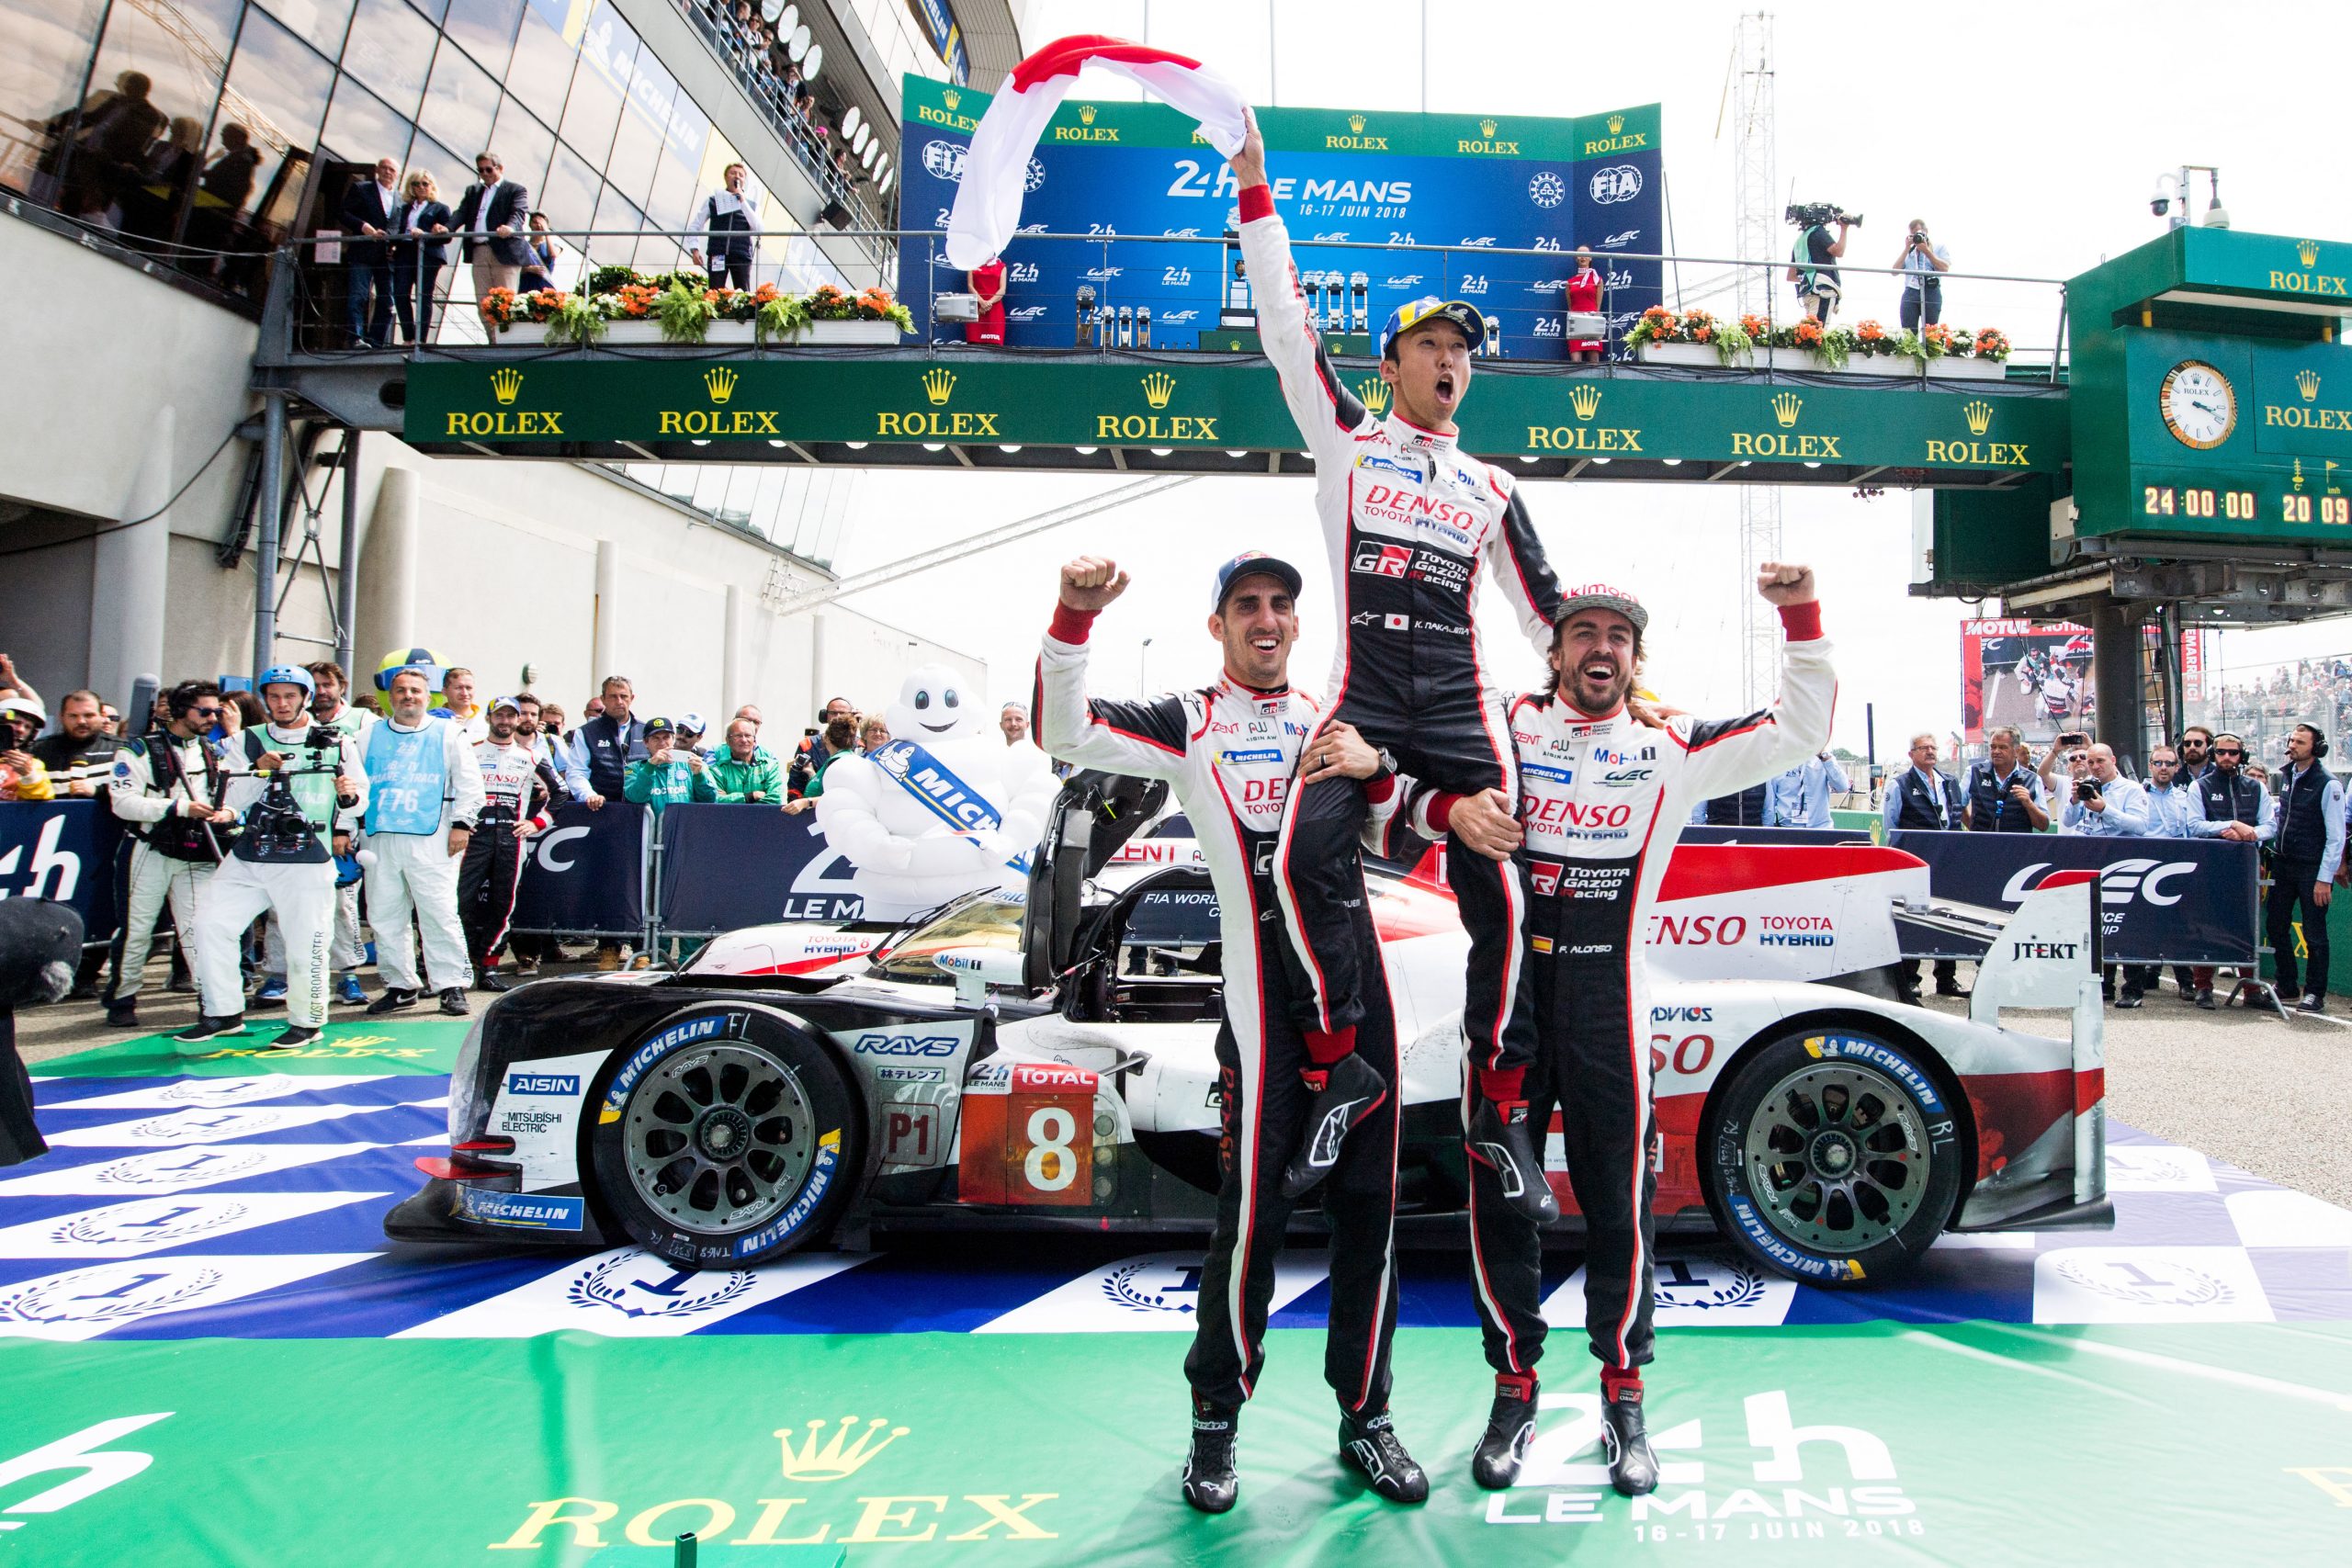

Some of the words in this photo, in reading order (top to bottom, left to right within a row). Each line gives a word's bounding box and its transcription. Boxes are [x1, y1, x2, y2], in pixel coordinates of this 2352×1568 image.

[613, 51, 700, 151] MICHELIN
[1055, 127, 1120, 141] ROLEX
[1326, 136, 1389, 150] ROLEX
[1457, 140, 1520, 154] ROLEX
[1585, 133, 1646, 154] ROLEX
[1273, 178, 1296, 199] E
[1302, 179, 1412, 204] MANS
[1299, 204, 1335, 217] 16-17
[1340, 205, 1370, 218] JUIN
[1374, 207, 1407, 219] 2018
[1164, 229, 1201, 237] WEC
[1314, 232, 1350, 242] WEC
[1605, 230, 1640, 244] WEC
[1461, 237, 1497, 246] WEC
[1011, 263, 1038, 277] 24h
[1087, 267, 1124, 277] WEC
[1162, 266, 1191, 281] 24h
[1387, 275, 1423, 285] WEC
[1461, 275, 1487, 289] 24h
[2269, 272, 2347, 296] ROLEX
[1010, 307, 1047, 317] WEC
[1162, 310, 1199, 321] WEC
[1533, 318, 1561, 333] 24h
[2183, 388, 2210, 396] ROLEX
[447, 412, 563, 435] ROLEX
[659, 412, 779, 434] ROLEX
[876, 413, 1000, 437] ROLEX
[2265, 406, 2352, 431] ROLEX
[1097, 415, 1218, 440] ROLEX
[1527, 426, 1644, 451] ROLEX
[1731, 433, 1841, 457] ROLEX
[1926, 441, 2030, 466] ROLEX
[1365, 484, 1474, 530] DENSO
[2283, 496, 2312, 523] 20
[2322, 498, 2350, 525] 09
[1364, 506, 1412, 525] TOYOTA
[1416, 517, 1468, 545] HYBRID
[1354, 554, 1407, 576] GR
[1415, 560, 1467, 581] GAZOO
[1408, 570, 1462, 592] Racing
[1964, 622, 2030, 635] MOTUL
[1212, 721, 1239, 734] ZENT
[1236, 752, 1277, 761] MICHELIN
[1522, 766, 1566, 780] MICHELIN
[1605, 770, 1653, 781] WEC
[111, 780, 132, 791] 35
[1245, 803, 1285, 815] TOYOT
[1522, 795, 1631, 828] DENSO
[1566, 828, 1629, 840] HYBRID
[1112, 842, 1176, 863] ENT
[1567, 866, 1631, 877] TOYOTA
[1564, 878, 1623, 888] GAZOO
[1145, 894, 1170, 904] FIA
[1175, 894, 1218, 905] WORL
[1559, 888, 1618, 901] Racing
[783, 899, 827, 919] LE
[1760, 917, 1833, 930] TOYOTA
[808, 935, 857, 943] TOYOTA
[1760, 933, 1833, 947] HYBRID
[805, 945, 856, 953] HYBRID
[1570, 944, 1612, 953] ALONSO
[2012, 942, 2077, 962] JTEKT
[311, 931, 324, 998] BROADCASTER
[939, 954, 968, 968] Mobil
[310, 1002, 322, 1023] HOST
[854, 1033, 960, 1057] RAYS
[619, 1020, 716, 1089] MICHELIN
[880, 1068, 942, 1080] 林テレンプ
[972, 1064, 1009, 1080] 24h
[1017, 1067, 1093, 1085] TOTAL
[1845, 1040, 1937, 1106] MICHELIN
[514, 1077, 574, 1092] AISIN
[507, 1111, 561, 1123] MITSUBISHI
[502, 1122, 547, 1134] ELECTRIC
[888, 1112, 929, 1156] P1
[1023, 1107, 1078, 1191] 8
[478, 1201, 570, 1220] MICHELIN
[741, 1168, 828, 1253] MICHELIN
[1735, 1203, 1826, 1275] MICHELIN
[1513, 1390, 1898, 1487] 24h
[1485, 1492, 1604, 1524] LE
[1631, 1485, 1916, 1521] MANS
[487, 1494, 1061, 1550] ROLEX
[1634, 1524, 1727, 1543] 16-17
[1749, 1520, 1826, 1540] JUIN
[1845, 1517, 1925, 1538] 2018
